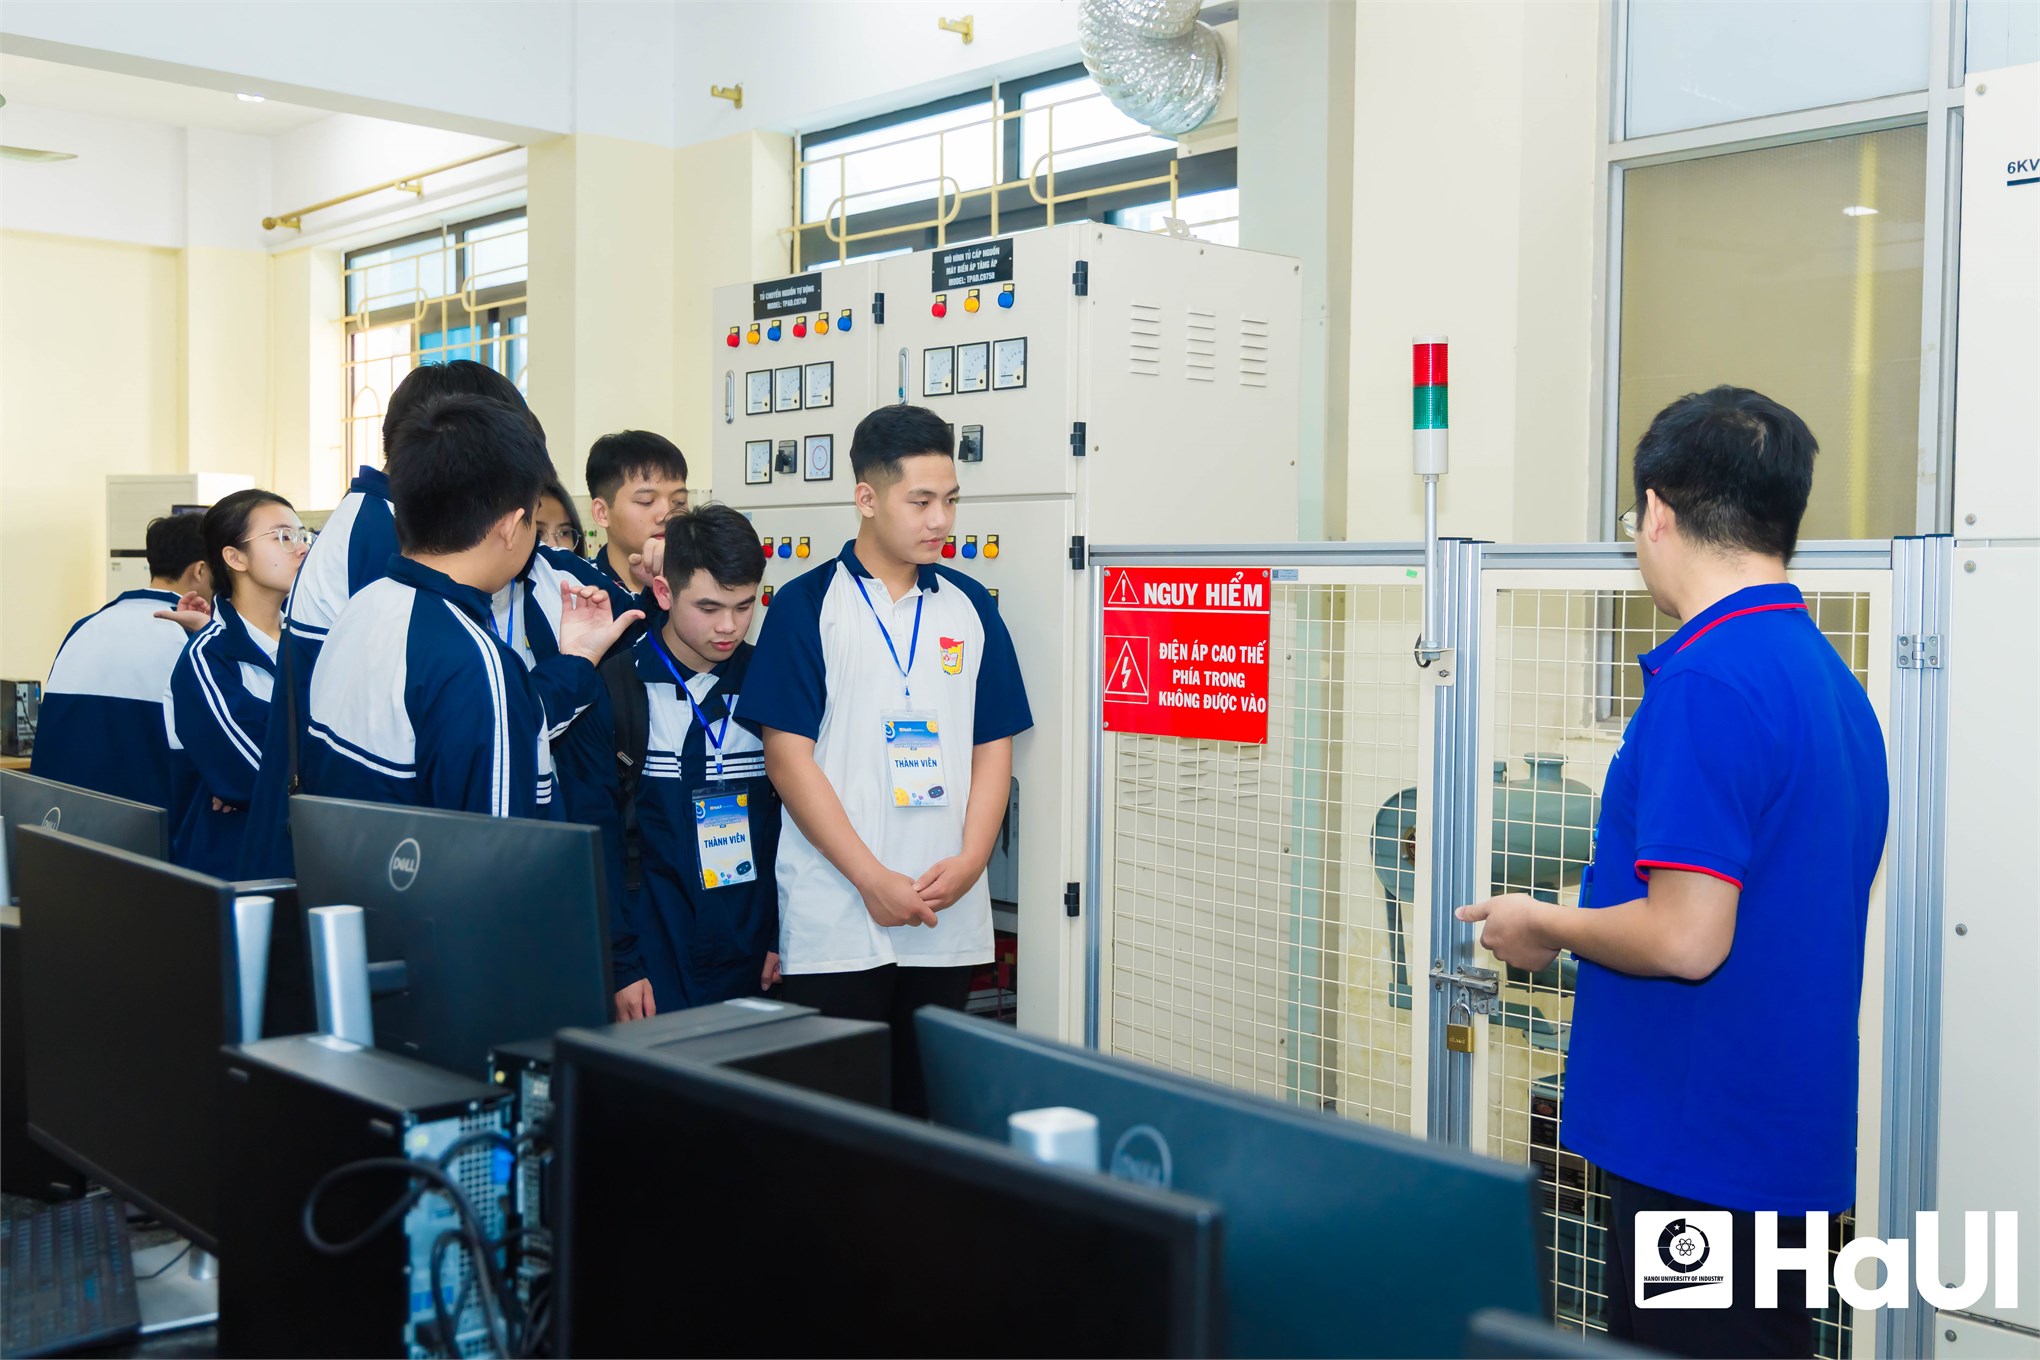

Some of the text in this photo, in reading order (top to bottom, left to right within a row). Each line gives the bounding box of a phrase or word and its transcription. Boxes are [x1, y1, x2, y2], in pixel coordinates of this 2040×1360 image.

[949, 276, 966, 286] MODEL:
[1144, 572, 1262, 607] NGUY HIỂM
[1159, 639, 1267, 664] ĐIỆN ÁP CAO THẾ
[1173, 666, 1246, 688] PHÍA TRONG
[1159, 689, 1267, 713] KHÔNG ĐƯỢC VÀO
[895, 756, 938, 768] THÀNH VIÊN
[704, 832, 746, 848] THÀNH VIÊN
